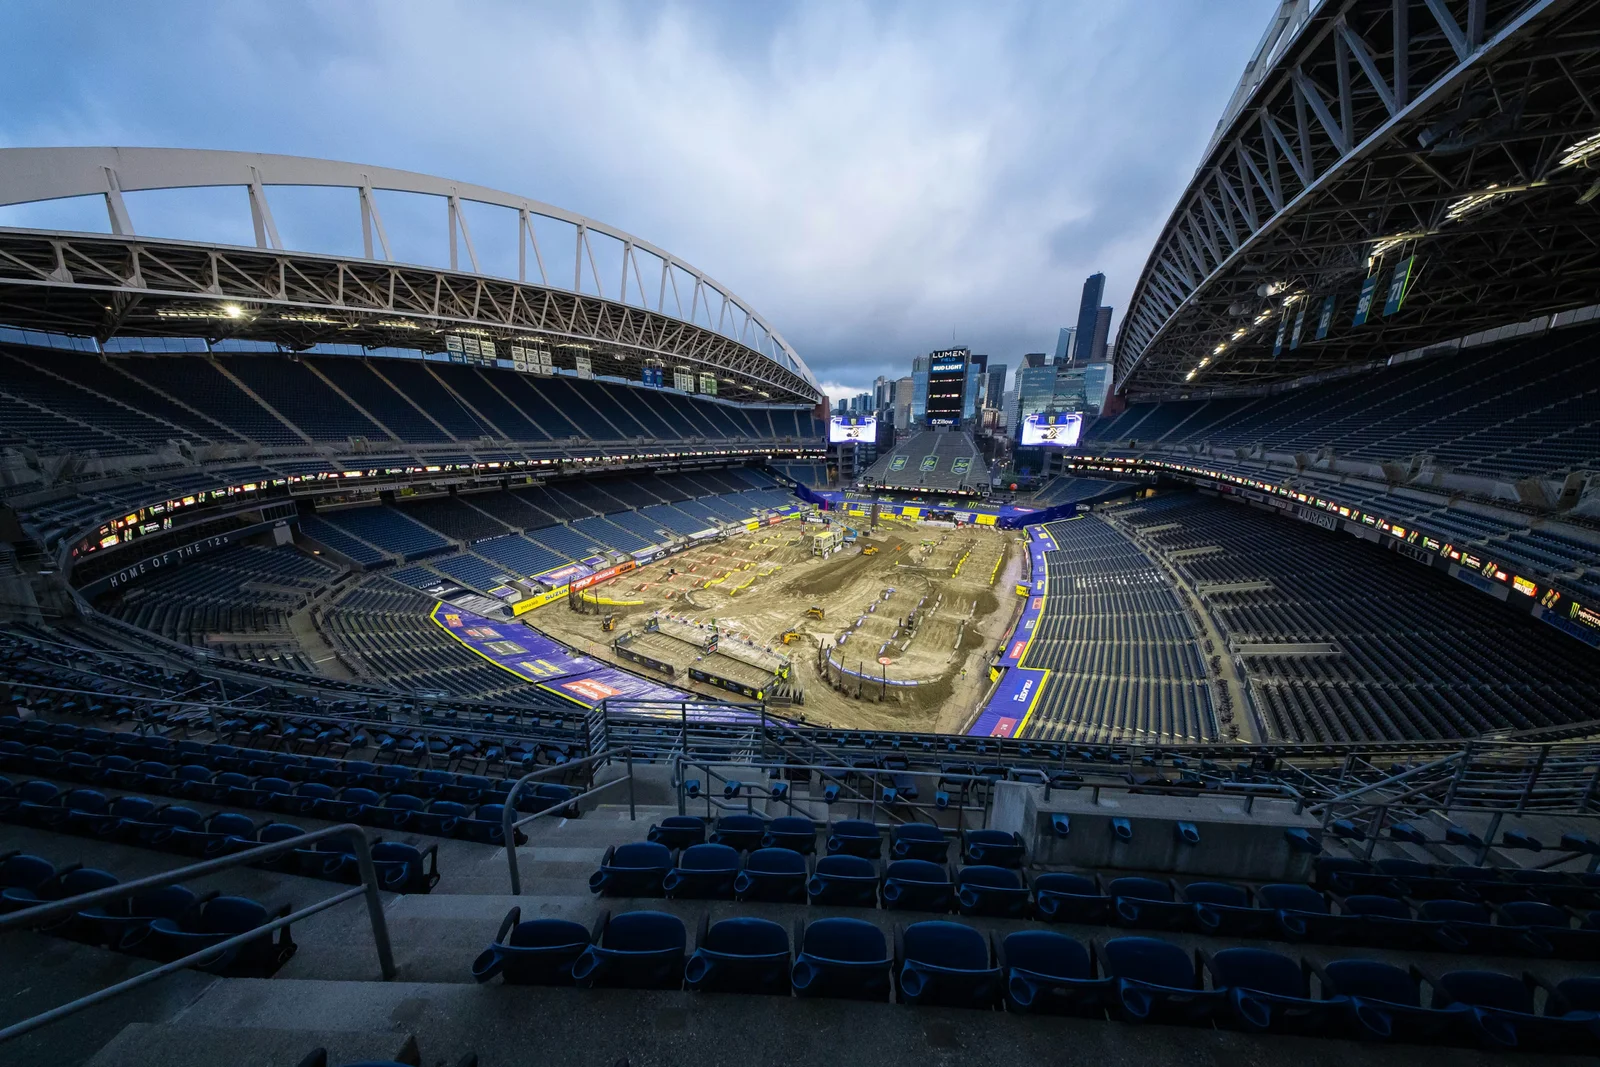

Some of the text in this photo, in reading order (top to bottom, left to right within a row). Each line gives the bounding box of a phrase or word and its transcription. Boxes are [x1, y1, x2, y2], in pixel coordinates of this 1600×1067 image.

[1389, 281, 1403, 303] 71
[1357, 295, 1370, 315] 96
[1320, 312, 1330, 329] 12
[932, 350, 965, 358] LUMEN
[1299, 508, 1334, 529] LUMEN
[110, 537, 229, 587] HOME OF THE 12s
[1397, 542, 1428, 564] DELTA
[418, 580, 441, 589] LUMEN
